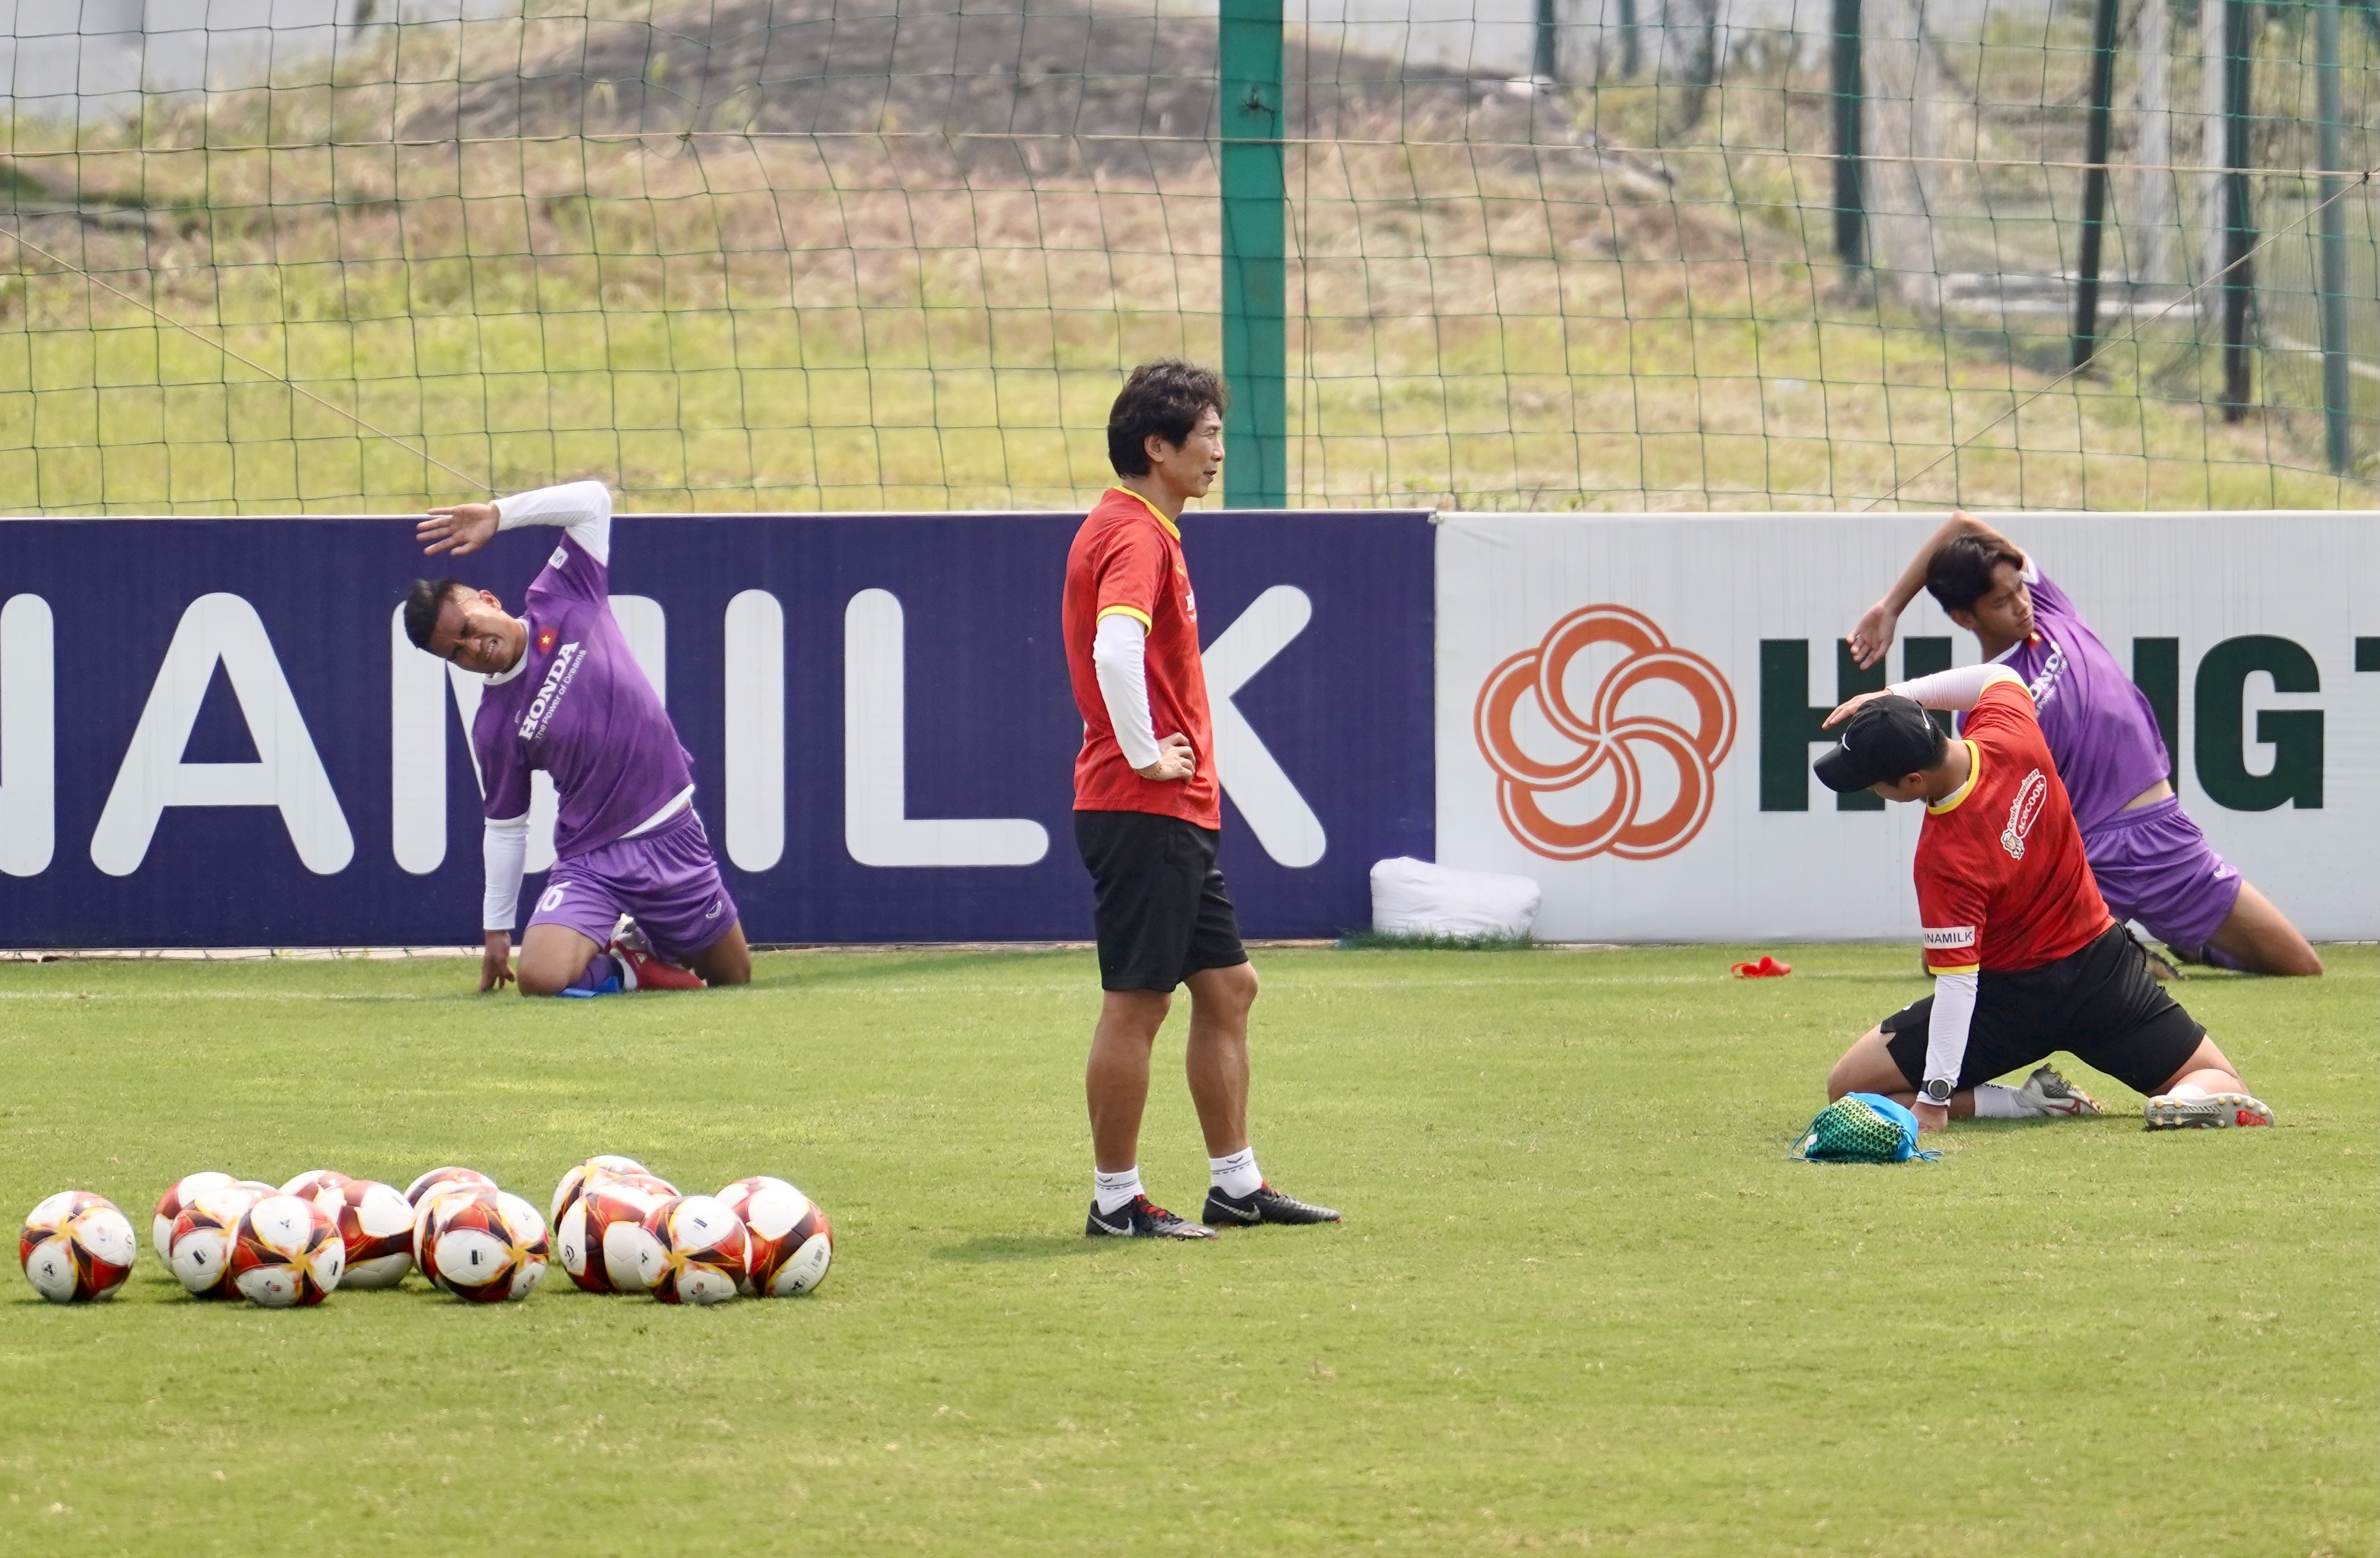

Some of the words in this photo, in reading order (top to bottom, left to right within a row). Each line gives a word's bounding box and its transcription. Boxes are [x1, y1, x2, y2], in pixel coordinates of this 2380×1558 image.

[519, 642, 580, 741] HONDA
[535, 724, 547, 740] The
[542, 696, 562, 724] Power
[558, 682, 568, 696] of
[563, 649, 587, 684] Dreams
[2029, 641, 2062, 701] OND
[0, 585, 1326, 877] AMILK
[1760, 634, 2325, 812] HG
[2008, 807, 2017, 829] Cook
[1924, 931, 1973, 943] INAMILK
